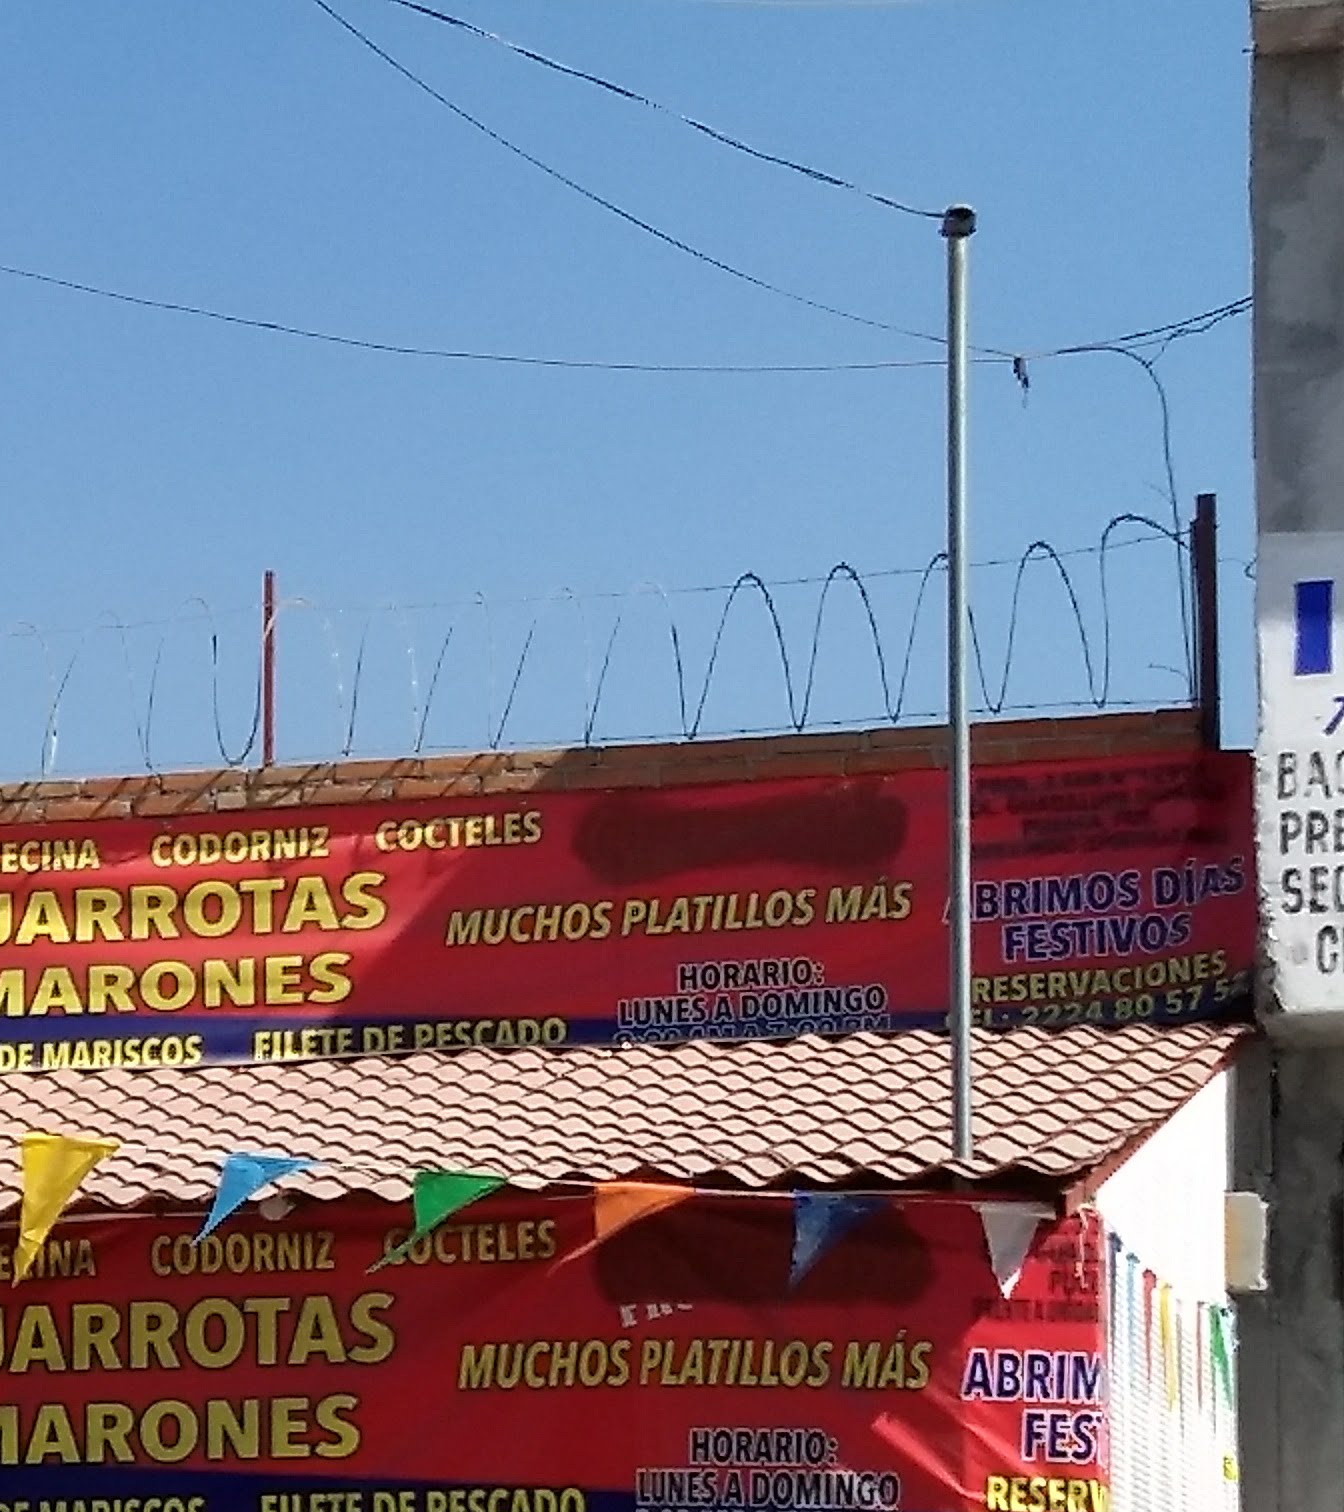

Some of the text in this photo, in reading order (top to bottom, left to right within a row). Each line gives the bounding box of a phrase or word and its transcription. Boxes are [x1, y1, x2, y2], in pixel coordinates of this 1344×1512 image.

[151, 826, 330, 869] CODORNIZ
[374, 811, 543, 854] COCTELES
[1152, 856, 1246, 909] DÍAS
[446, 878, 913, 948] MUCHOS PLATILLOS MÁS
[1002, 912, 1192, 962] FESTIVOS
[677, 956, 826, 994] HORARIO:
[971, 949, 1228, 1004] RESERVACIONES
[618, 983, 889, 1030] LUNES A DOMINGO
[40, 1035, 203, 1071] MARISCOS
[254, 1016, 567, 1063] FILETE DE PESCADO
[150, 1231, 336, 1277] CODORNIZ
[457, 1329, 934, 1391] MUCHOS PLATILLOS MÁS
[689, 1428, 839, 1467] HORARIO:
[636, 1469, 900, 1510] LUNES A DOMINGO
